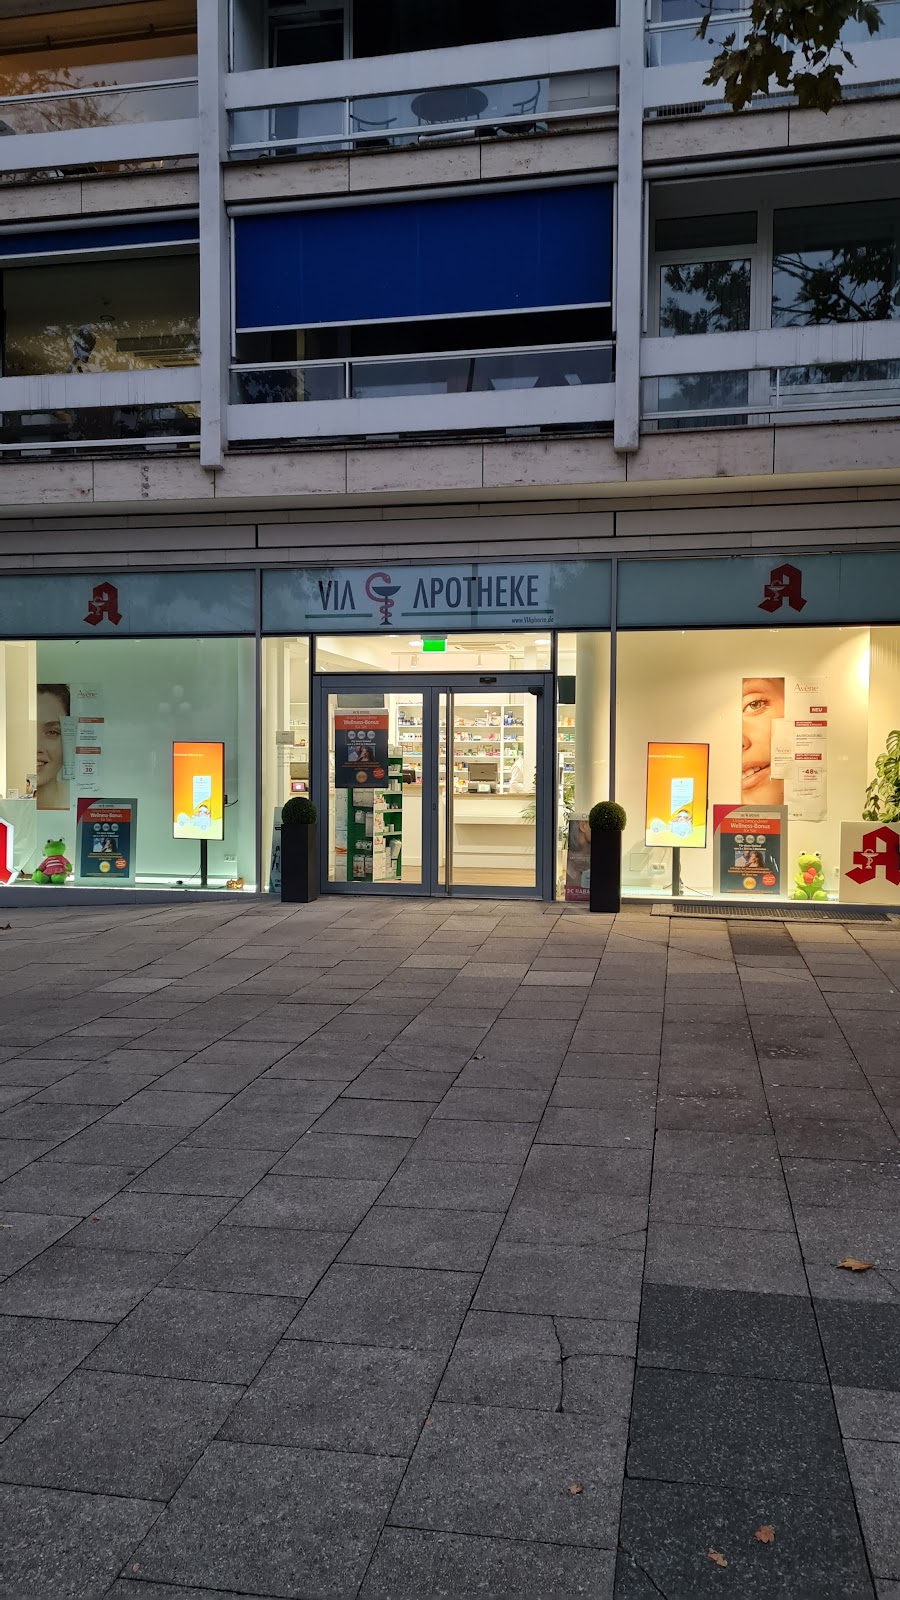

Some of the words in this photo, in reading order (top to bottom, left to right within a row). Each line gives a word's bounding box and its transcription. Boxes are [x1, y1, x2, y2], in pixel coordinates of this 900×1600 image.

[318, 580, 356, 610] VIA
[413, 575, 539, 609] APOTHEKE
[794, 683, 819, 692] Avène
